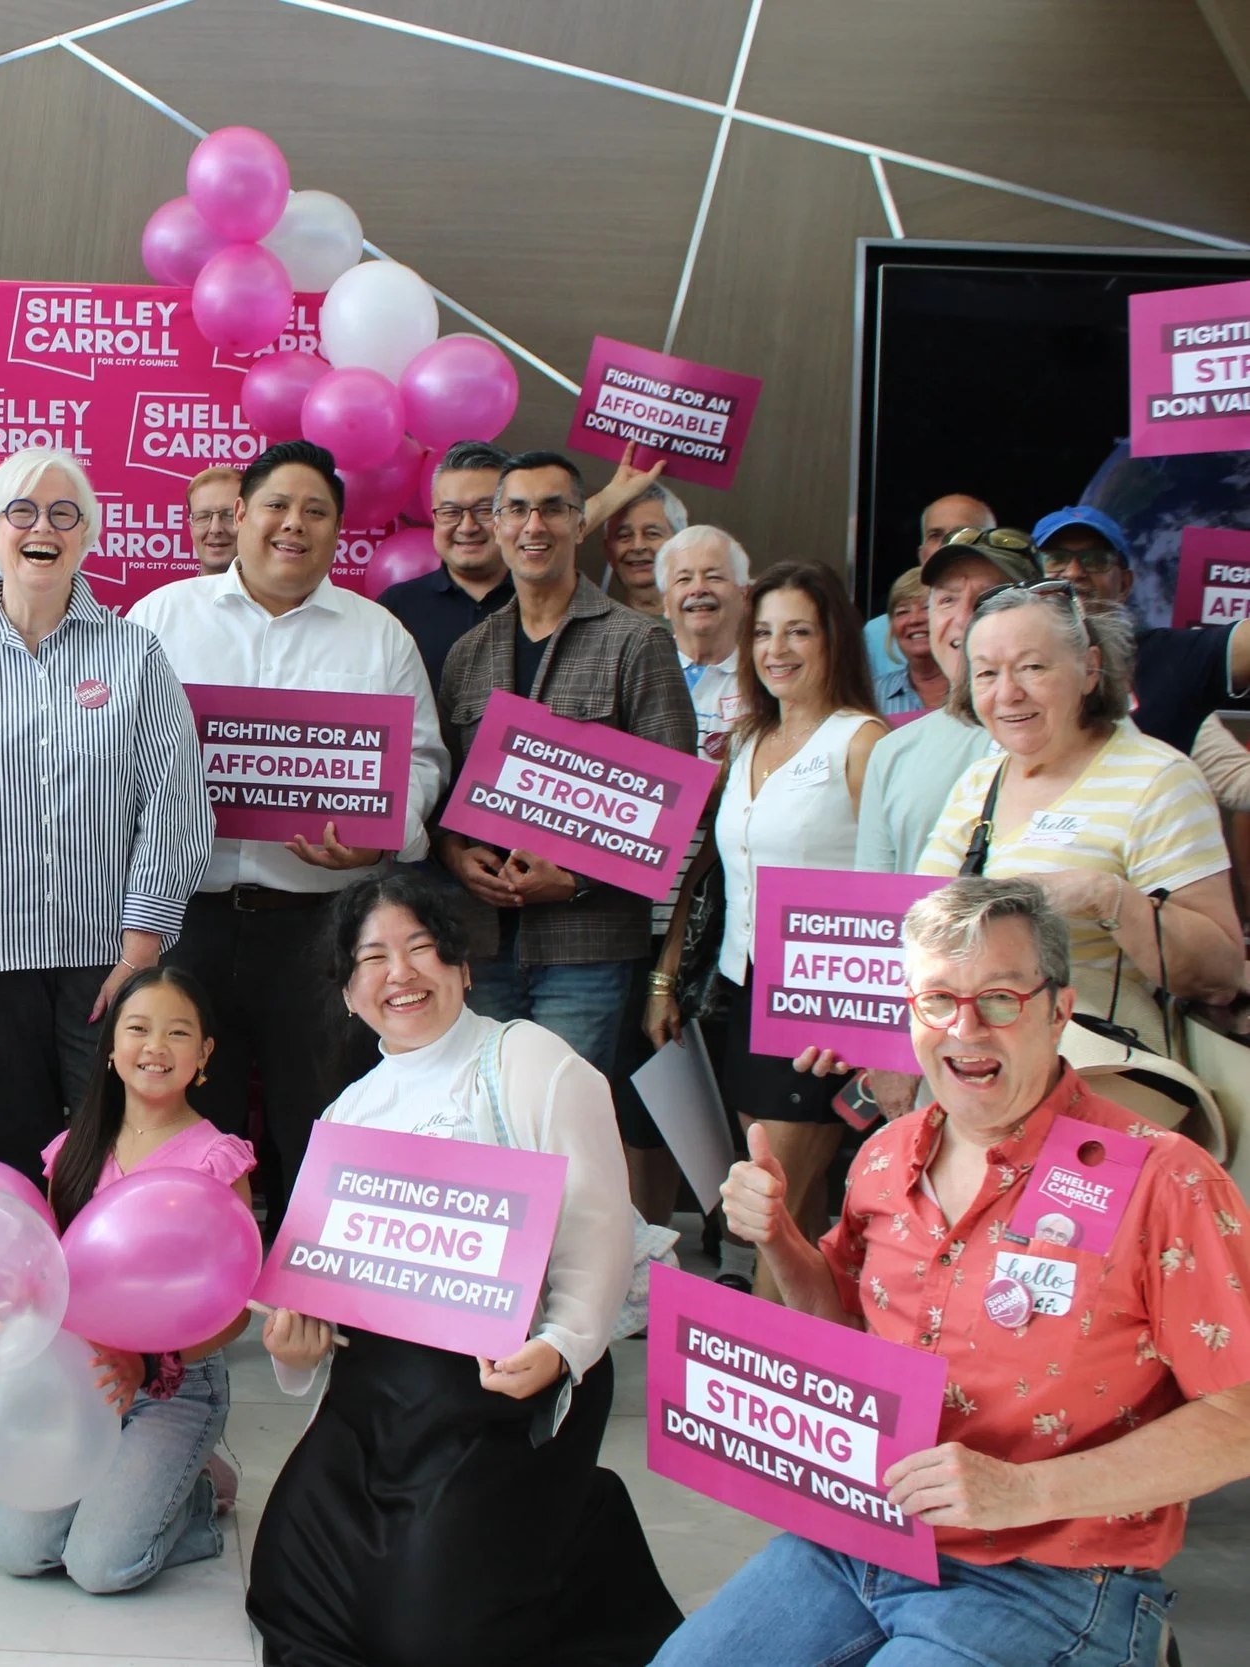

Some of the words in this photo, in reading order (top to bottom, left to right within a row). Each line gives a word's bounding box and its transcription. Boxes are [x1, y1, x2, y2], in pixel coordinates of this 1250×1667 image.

[25, 298, 178, 327] SHELLEY
[24, 327, 179, 356] CARROLL
[97, 357, 114, 365] FOR
[116, 358, 137, 366] CITY
[139, 358, 178, 367] COUNCIL
[606, 368, 670, 397] FIGHTING
[672, 388, 704, 407] FOR
[706, 398, 731, 414] AN
[1152, 395, 1206, 418] DON
[143, 403, 250, 429] SHELL
[600, 394, 722, 436] AFFORDABLE
[586, 414, 617, 434] DON
[619, 424, 670, 448] VALLEY
[670, 439, 726, 462] NORTH
[147, 562, 168, 570] CITY
[349, 568, 366, 576] CIT
[207, 721, 301, 743] FIGHTING
[306, 727, 345, 745] FOR
[351, 730, 380, 747] AN
[207, 753, 375, 781] AFFORDABLE
[512, 734, 604, 778] FIGHTING
[607, 768, 647, 794] FOR
[649, 784, 664, 800] A
[207, 785, 236, 802] ON
[242, 788, 312, 808] VALLEY
[317, 793, 387, 813] NORTH
[516, 768, 638, 824] STRONG
[471, 787, 517, 815] DON
[521, 803, 591, 839] VALLEY
[591, 831, 662, 865] NORTH
[1035, 814, 1080, 830] hello
[789, 912, 895, 941] FIGHTING
[790, 953, 908, 986] AFFORD
[772, 992, 821, 1016] DON
[827, 997, 905, 1025] VALLEY
[338, 1171, 440, 1207] FIGHTING
[443, 1189, 487, 1217] FOR
[493, 1198, 509, 1220] A
[1047, 1181, 1108, 1210] CARROLL
[1051, 1171, 1114, 1197] SHELLEY
[343, 1212, 482, 1262] STRONG
[290, 1246, 343, 1275] DON
[349, 1259, 429, 1293] VALLEY
[430, 1275, 513, 1312] NORTH
[1002, 1258, 1068, 1289] hello
[688, 1327, 797, 1390] FIGHTING
[803, 1371, 853, 1413] FOR
[859, 1394, 878, 1423] A
[707, 1379, 852, 1463] STRONG
[667, 1409, 715, 1450] DON
[720, 1432, 804, 1487] VALLEY
[811, 1471, 904, 1526] NORTH
